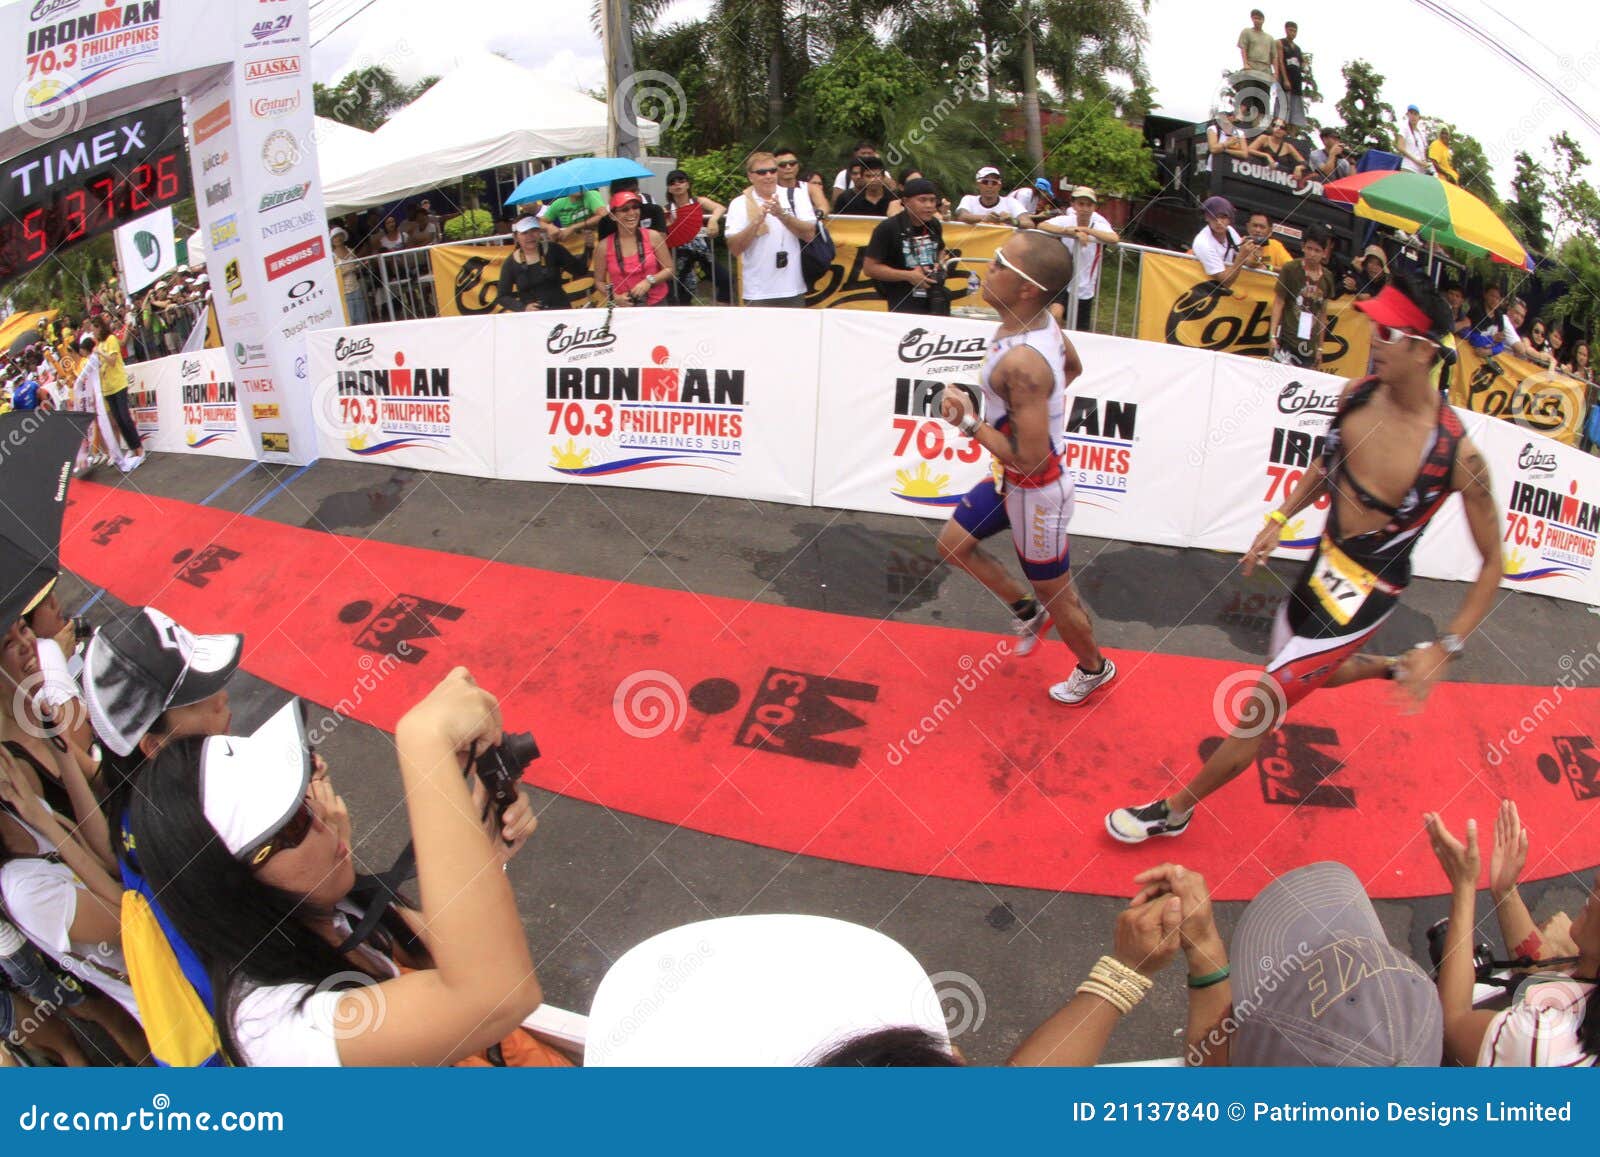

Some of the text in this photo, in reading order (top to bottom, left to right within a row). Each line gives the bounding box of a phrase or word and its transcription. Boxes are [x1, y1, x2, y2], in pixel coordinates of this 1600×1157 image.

[27, 0, 160, 55] IRONMAN
[252, 14, 293, 33] AIR 21
[27, 25, 160, 82] 70.3 PHILIPPINES
[247, 58, 299, 78] ALASKA
[254, 94, 298, 117] Century
[11, 121, 145, 197] TIMEX
[1231, 158, 1297, 189] TOURING
[262, 210, 316, 239] INTERCARE
[282, 288, 325, 313] OAKLEY
[335, 337, 374, 361] Cobra
[547, 323, 617, 354] Cobra
[898, 328, 987, 364] Cobra
[182, 382, 236, 404] IRONMAN
[242, 379, 276, 393] TIMEX
[337, 368, 450, 397] IRONMAN
[547, 367, 745, 406] IRONMAN
[340, 398, 450, 425] 70.3 PHILIPPINES
[547, 402, 743, 438] 70.3 PHILIPPINES
[620, 434, 741, 450] CAMARINES SUR
[1518, 443, 1557, 471] Cobra
[1509, 480, 1600, 533] IRONMAN
[1504, 513, 1597, 558] 70.3 PHILIPPINES
[743, 671, 808, 749] 70.3
